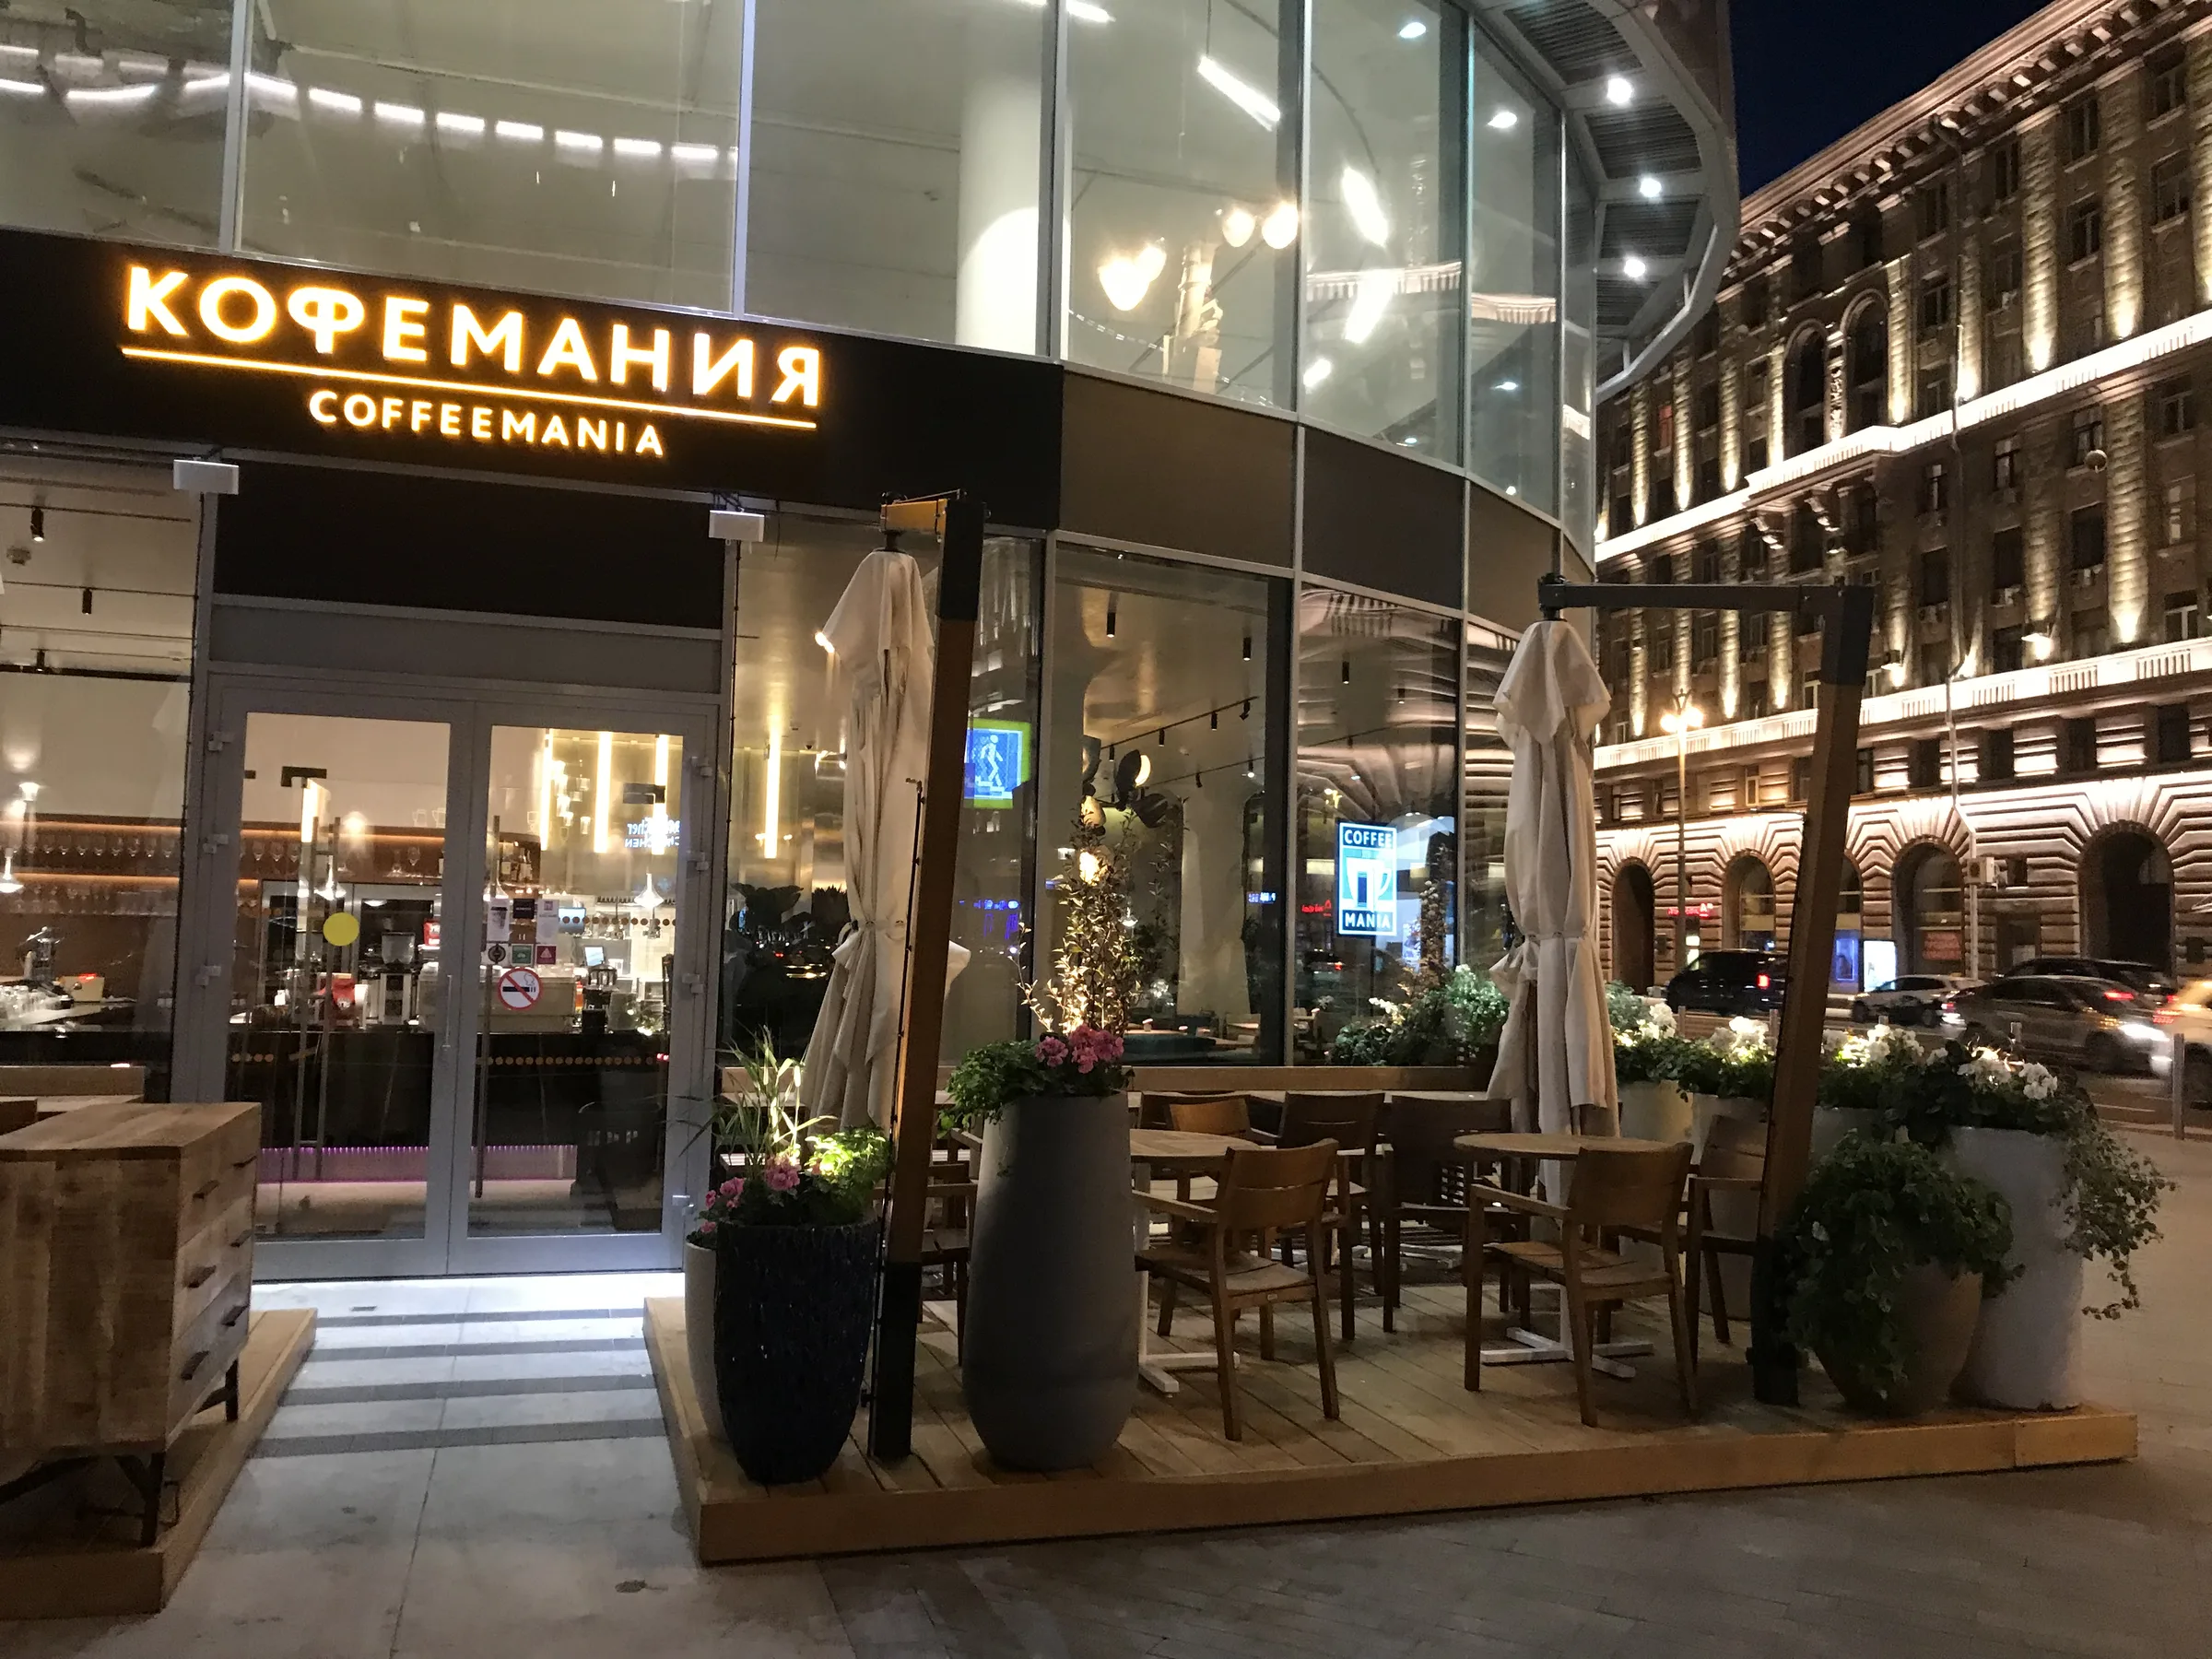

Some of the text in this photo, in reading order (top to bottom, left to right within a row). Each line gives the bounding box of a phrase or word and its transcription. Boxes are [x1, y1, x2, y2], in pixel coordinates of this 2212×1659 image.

[125, 265, 820, 407] КОФЕМАНИЯ
[307, 388, 665, 459] COFFEEMANIA
[1345, 830, 1392, 848] COFFEE
[1346, 912, 1390, 928] MANIA
